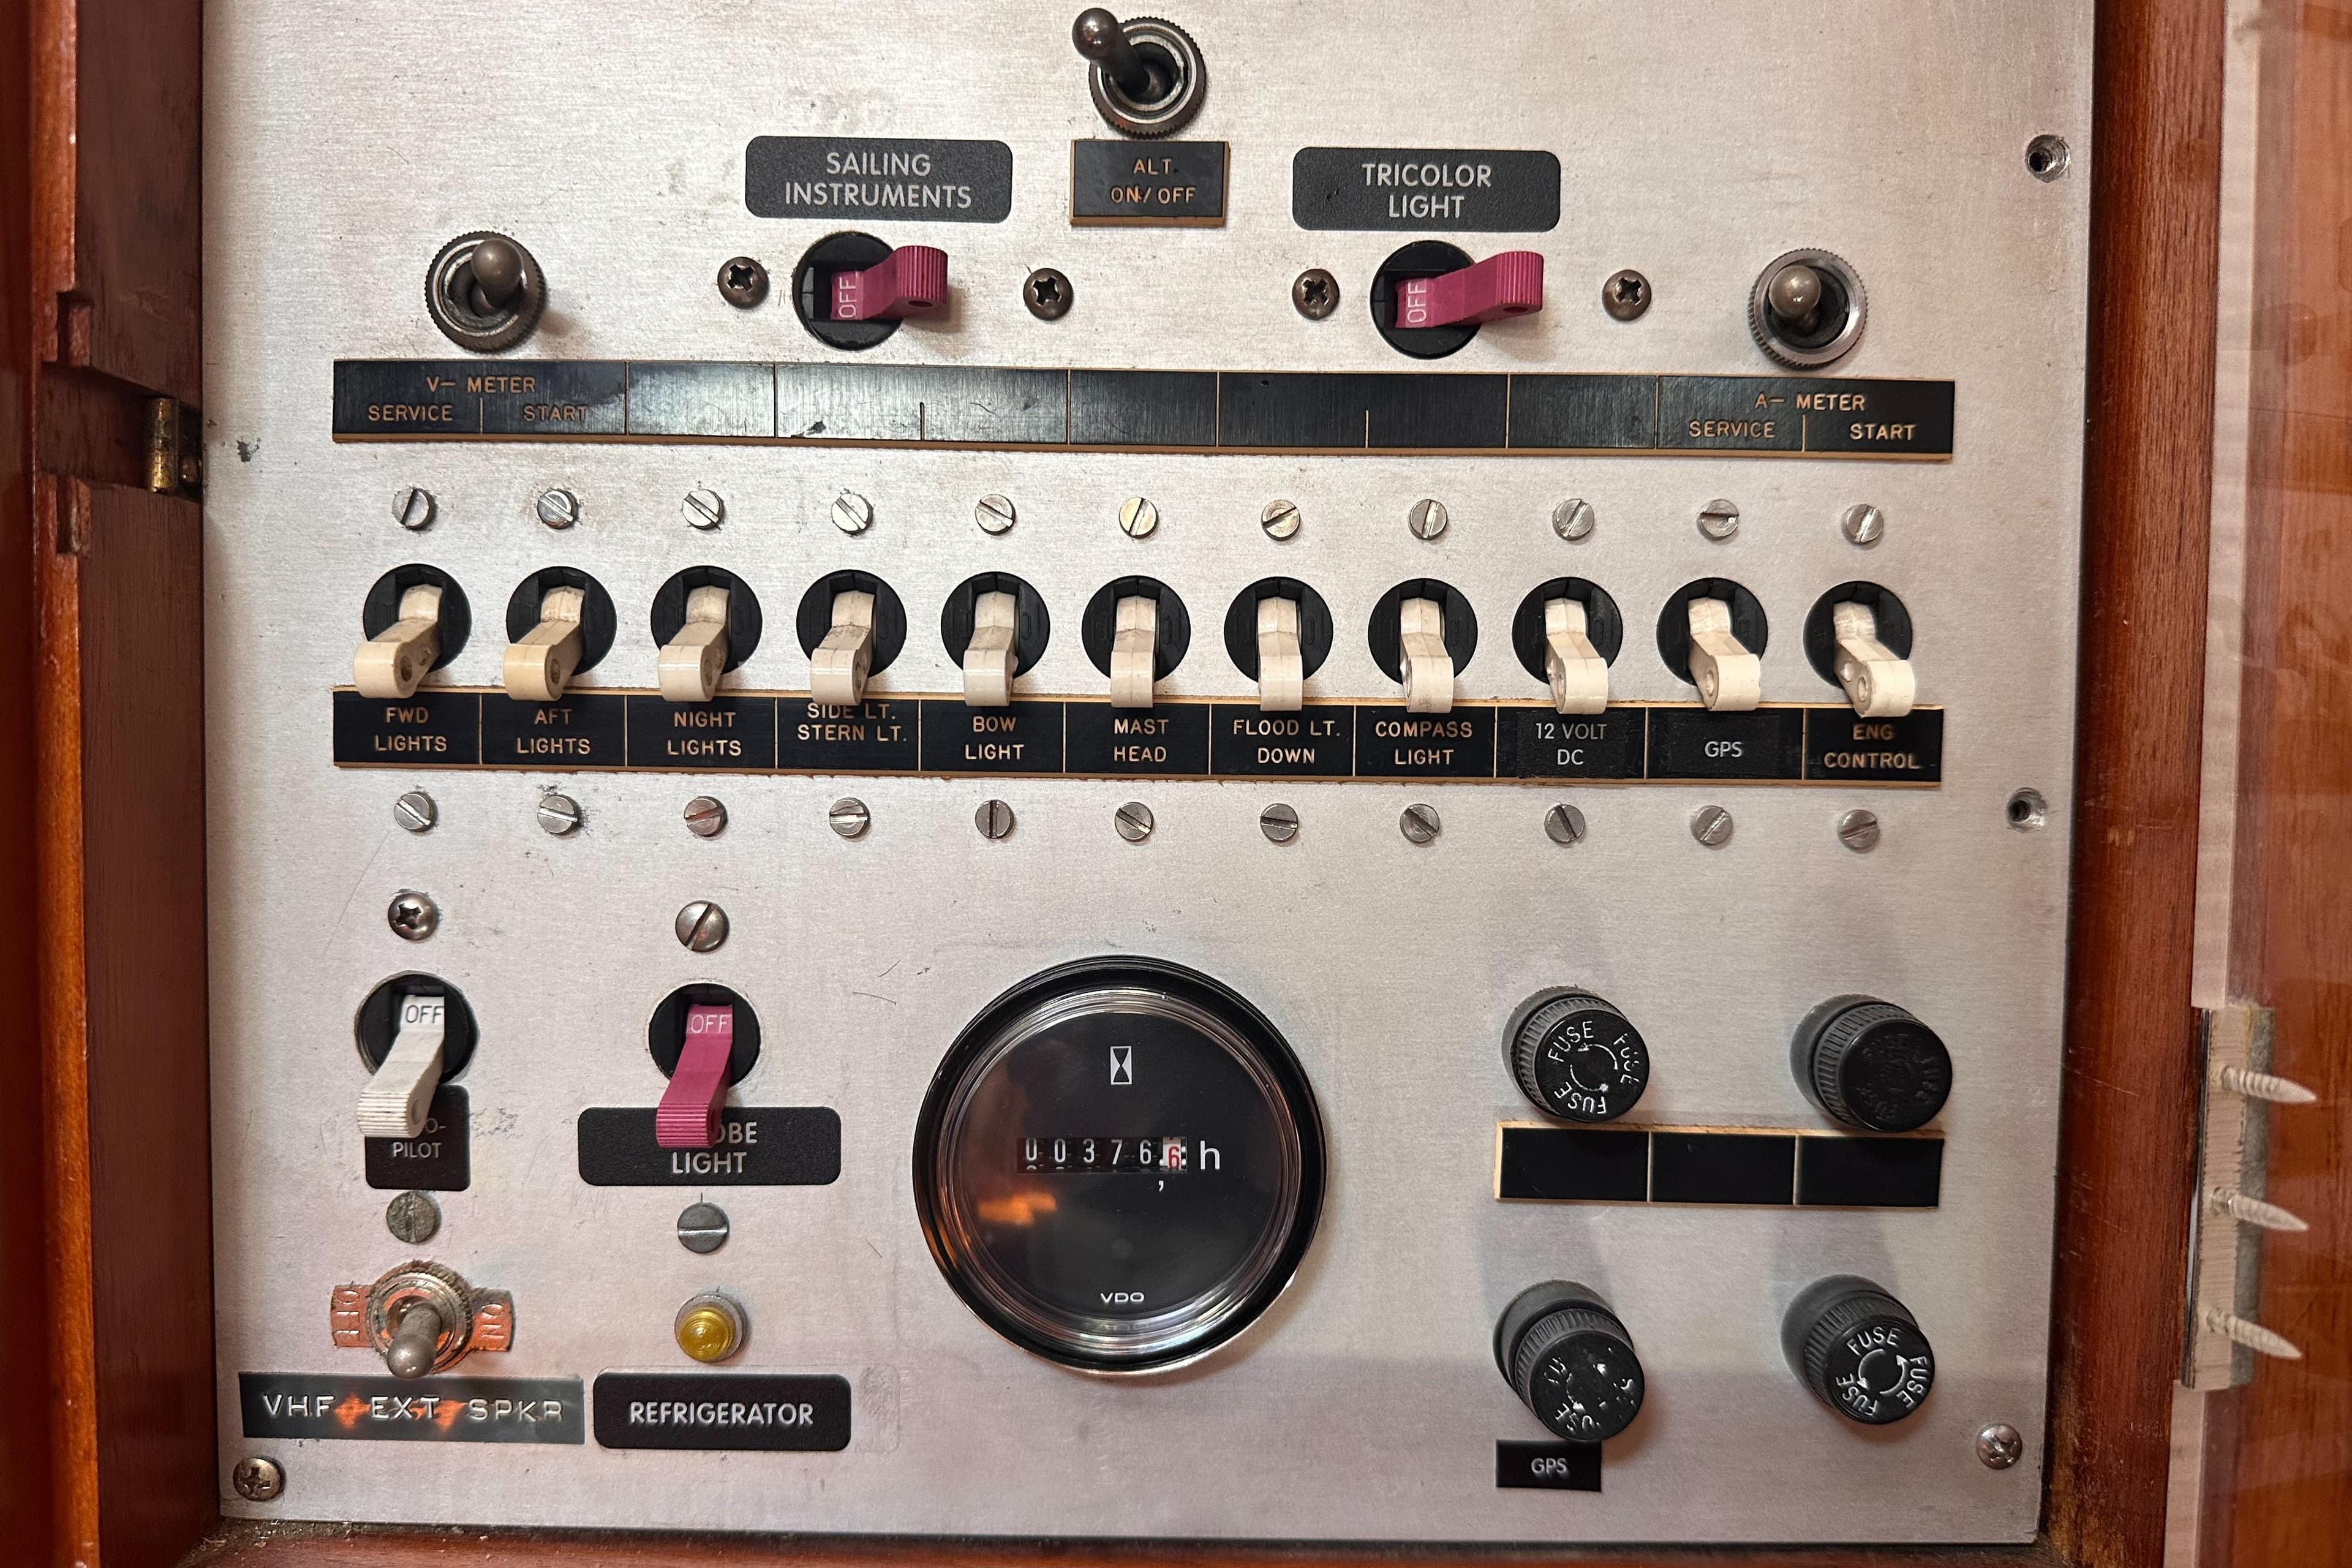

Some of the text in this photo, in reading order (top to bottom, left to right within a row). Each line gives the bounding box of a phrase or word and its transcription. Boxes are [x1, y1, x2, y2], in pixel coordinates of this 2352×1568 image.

[826, 153, 931, 176] SAILING
[1362, 164, 1491, 187] TRICOLOR
[785, 182, 971, 209] INSTRUMENTS
[1389, 195, 1464, 219] LIGHT
[839, 276, 857, 318] OFF
[1406, 282, 1427, 324] OFF
[467, 377, 536, 393] METER
[1796, 393, 1866, 412] METER
[368, 404, 453, 422] SERVICE
[523, 405, 588, 422] START
[1689, 420, 1776, 439] SERVICE
[1850, 423, 1917, 441] START
[385, 706, 429, 724] FWD
[533, 708, 573, 725] AFT
[673, 711, 736, 728] NIGHT
[807, 702, 897, 720] SIDE LT.
[797, 723, 908, 742] STERN LT.
[972, 715, 1017, 733] BOW
[1114, 718, 1170, 735] MAST
[1232, 719, 1341, 737] FLOOD LT.
[1374, 720, 1473, 738] COMPASS
[1536, 723, 1608, 741] 12 VOLT
[1852, 723, 1894, 741] ENG
[374, 735, 447, 752] LIGHTS
[516, 737, 591, 755] LIGHTS
[666, 739, 742, 756] LIGHTS
[965, 743, 1025, 761] LIGHT
[1704, 741, 1743, 758] GPS
[1114, 745, 1167, 763] HEAD
[1257, 747, 1316, 764] DOWN
[1394, 748, 1455, 765] LIGHT
[1556, 748, 1585, 766] DC
[1823, 752, 1920, 769] CONTROL
[405, 1005, 445, 1023] OFF
[690, 1013, 732, 1034] OFF
[1547, 1020, 1594, 1063] FUSE
[1553, 1081, 1607, 1115] FUSE
[392, 1142, 443, 1158] PILOT
[1199, 1140, 1221, 1170] h
[673, 1152, 747, 1174] LIGHT
[1100, 1292, 1145, 1303] VDO
[1847, 1326, 1901, 1357] FUSE
[1896, 1355, 1929, 1409] FUSE
[1835, 1373, 1879, 1416] FUSE
[263, 1393, 564, 1422] VHF EXT SPKR
[630, 1401, 814, 1425] REFRIGERATOR
[1531, 1458, 1569, 1474] GPS
